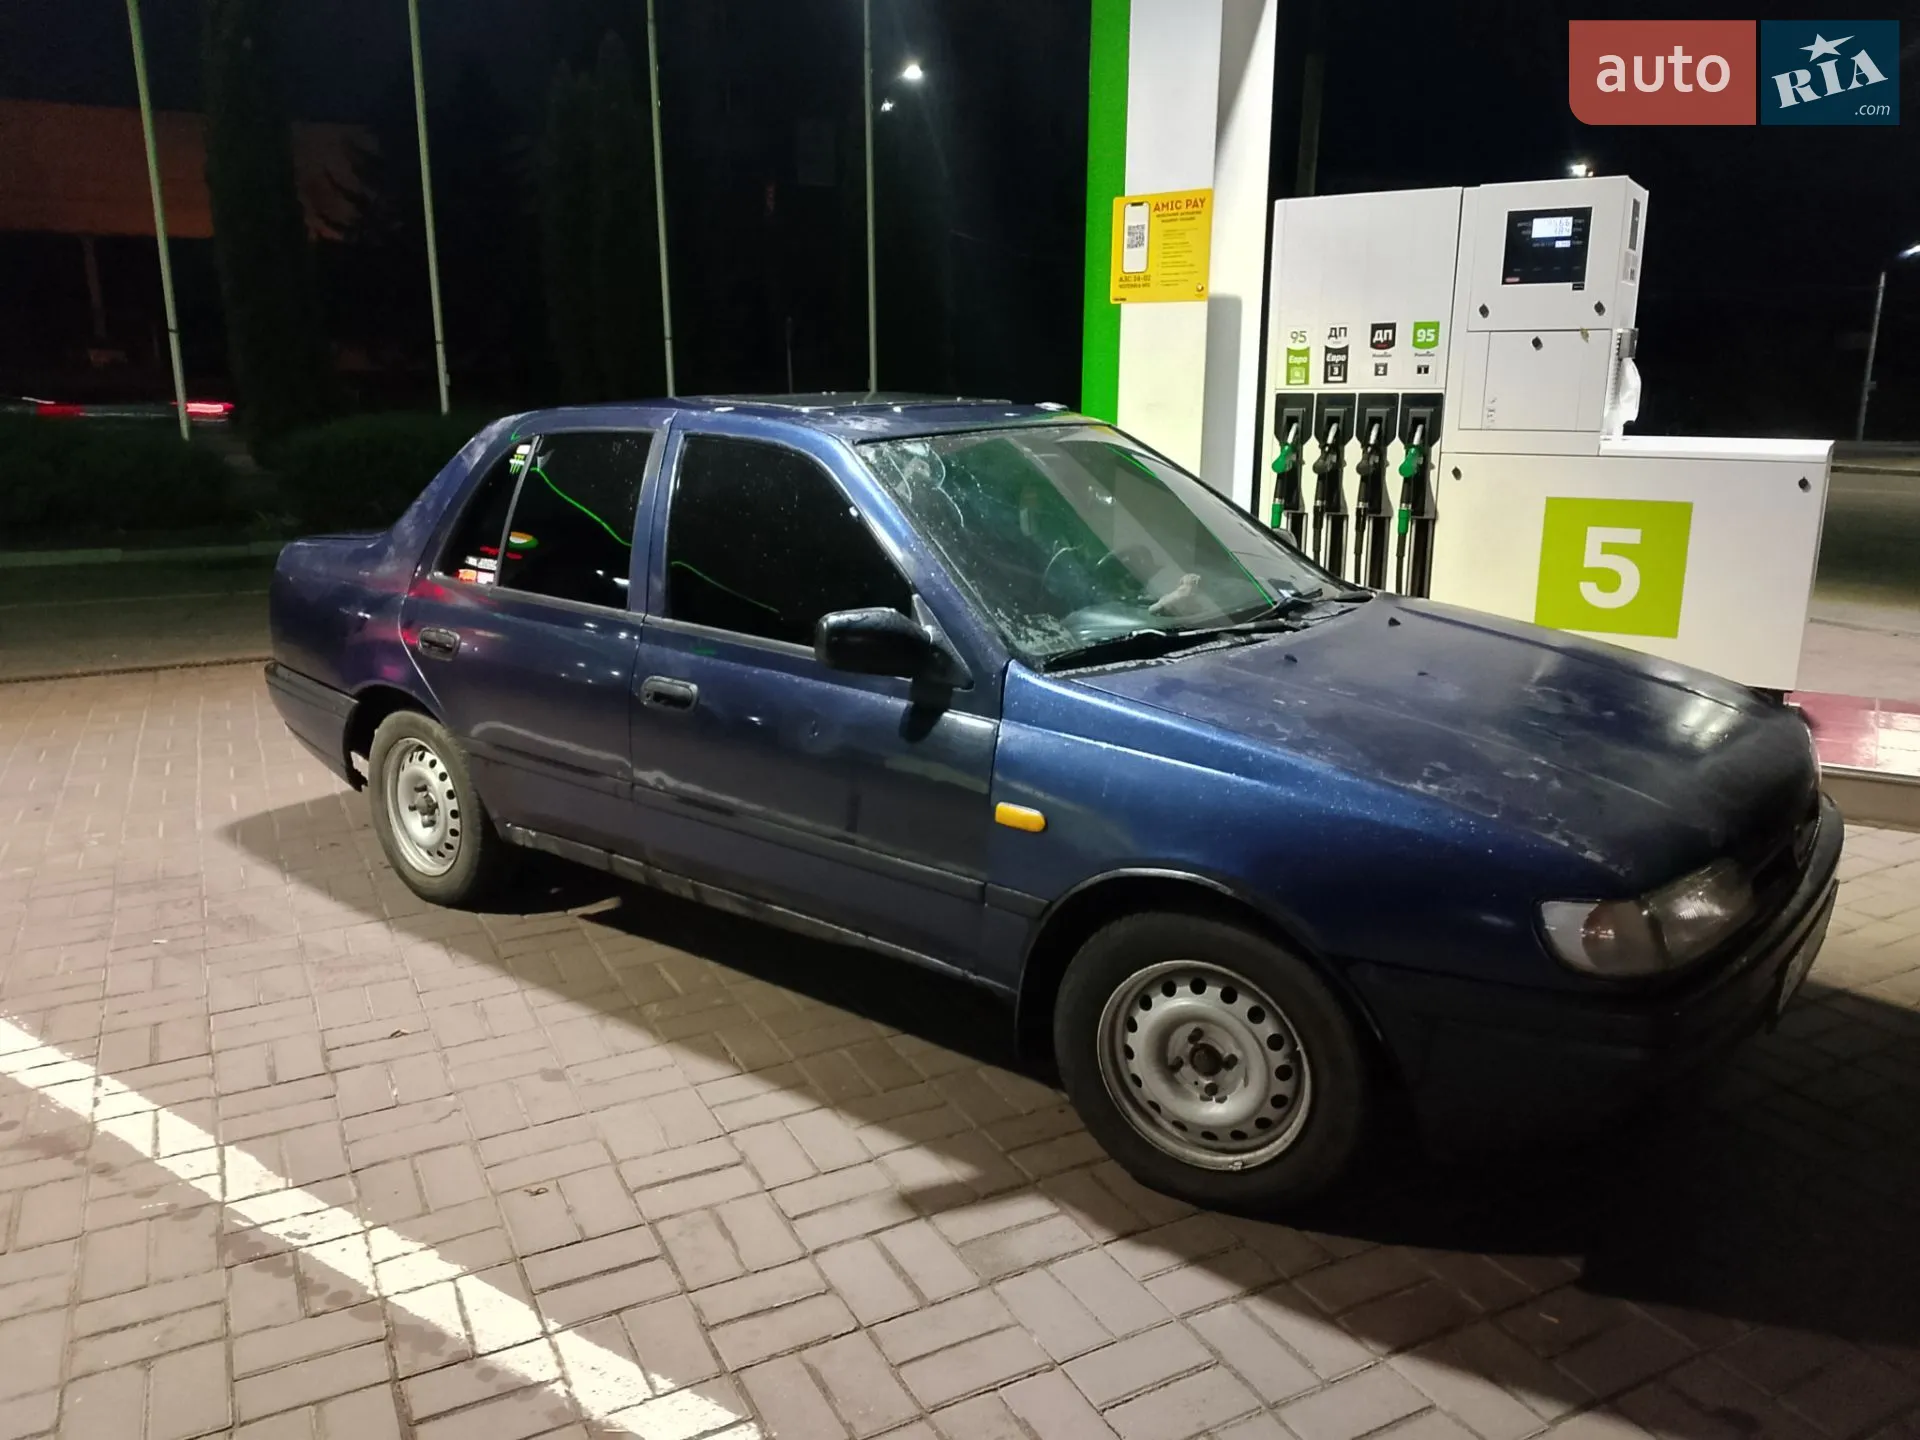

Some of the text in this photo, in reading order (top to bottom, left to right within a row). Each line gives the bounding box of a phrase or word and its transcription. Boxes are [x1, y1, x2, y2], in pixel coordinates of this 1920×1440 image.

[1153, 197, 1206, 212] AMIC PAY
[1290, 330, 1307, 343] 95
[1327, 326, 1348, 340] ДП
[1372, 329, 1393, 343] ДП
[1417, 329, 1436, 342] 95
[1332, 367, 1339, 375] 3
[1377, 366, 1385, 375] 2
[1579, 526, 1642, 609] 5
